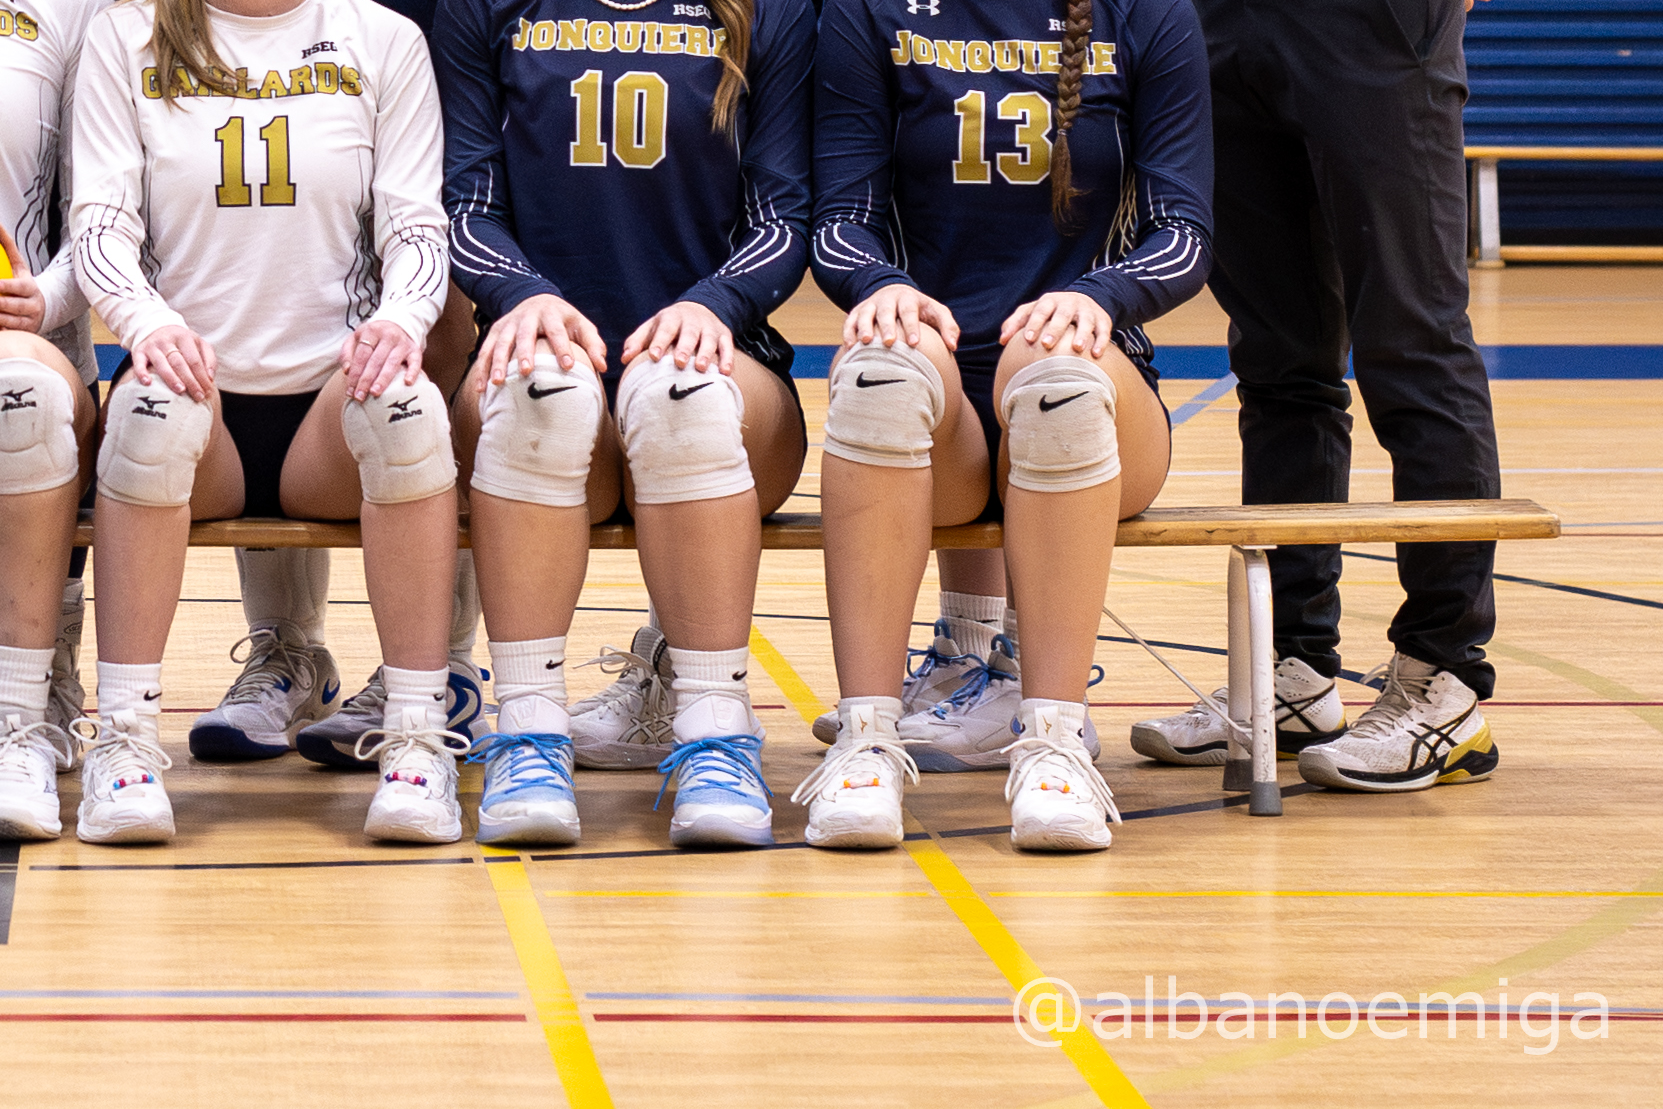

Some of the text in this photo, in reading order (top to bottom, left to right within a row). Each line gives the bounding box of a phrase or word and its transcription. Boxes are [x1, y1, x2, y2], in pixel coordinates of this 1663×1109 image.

[673, 4, 712, 20] RSEQ
[890, 30, 1117, 75] JONQUIEE
[214, 115, 297, 208] 11
[569, 68, 669, 169] 10
[952, 90, 1054, 185] 13
